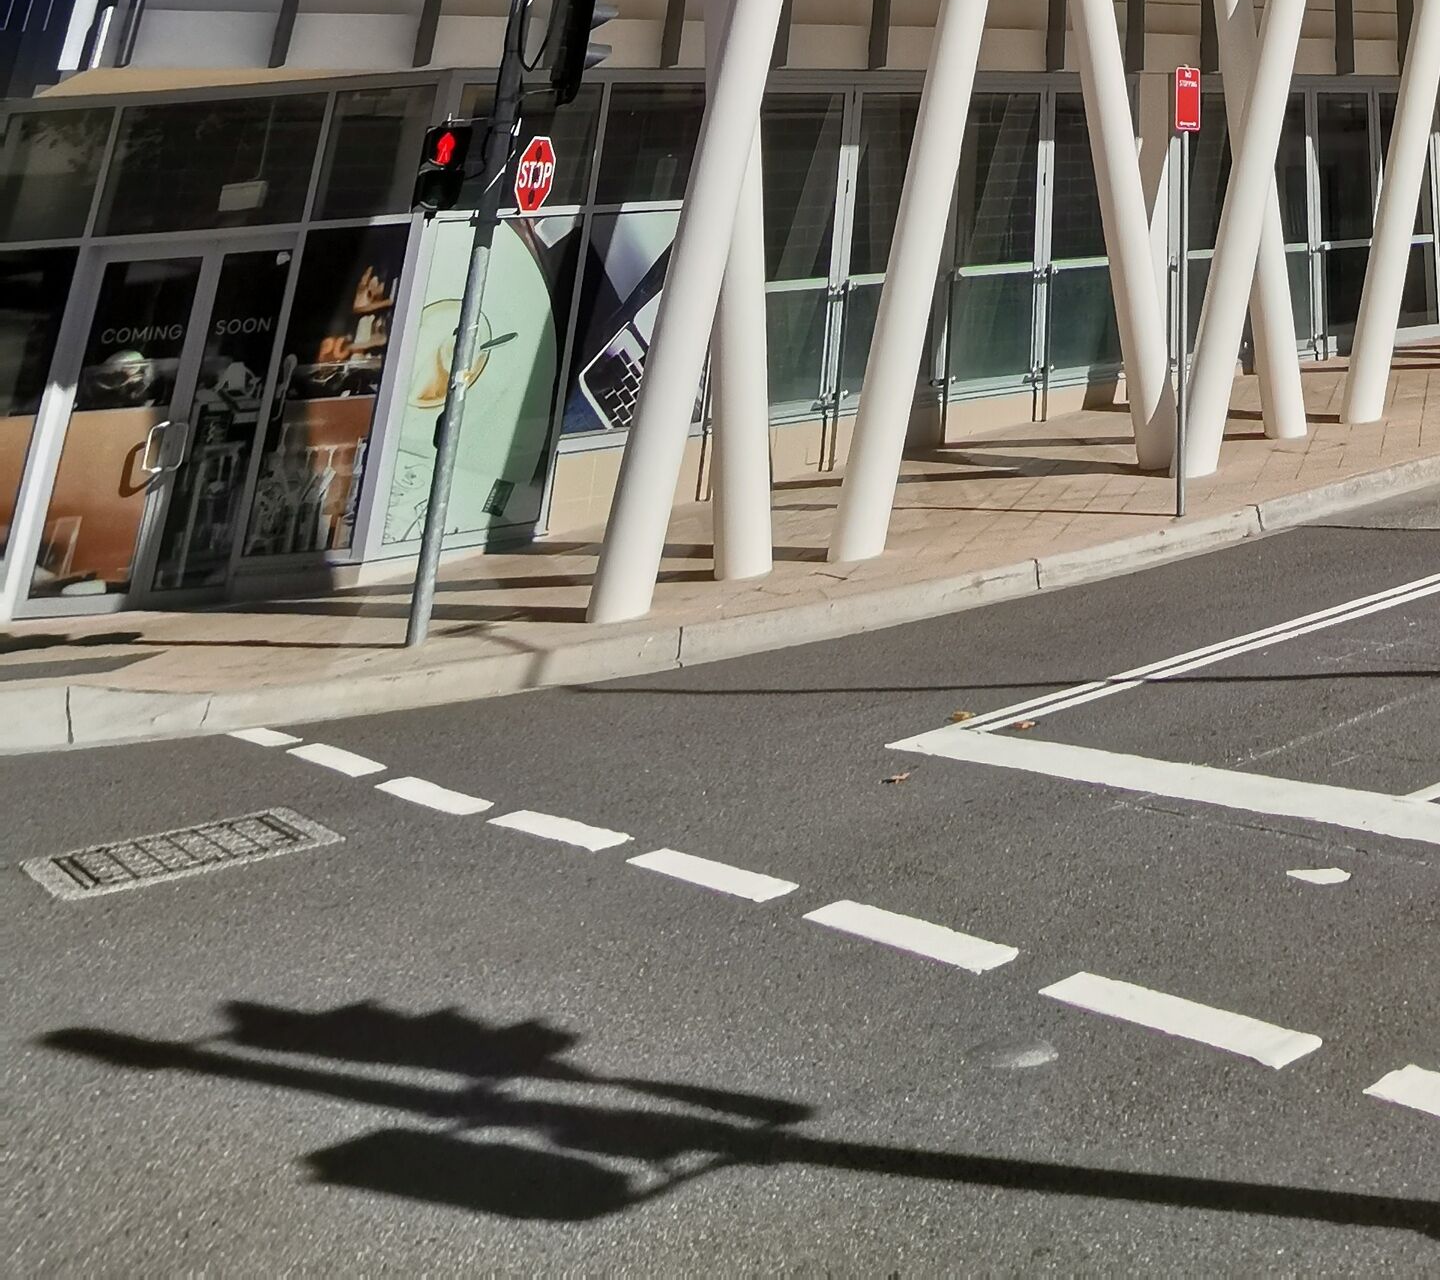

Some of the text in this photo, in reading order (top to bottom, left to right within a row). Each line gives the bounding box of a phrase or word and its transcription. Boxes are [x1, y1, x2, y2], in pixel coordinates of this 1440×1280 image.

[519, 160, 552, 189] STOP
[101, 316, 273, 345] COMING SOON
